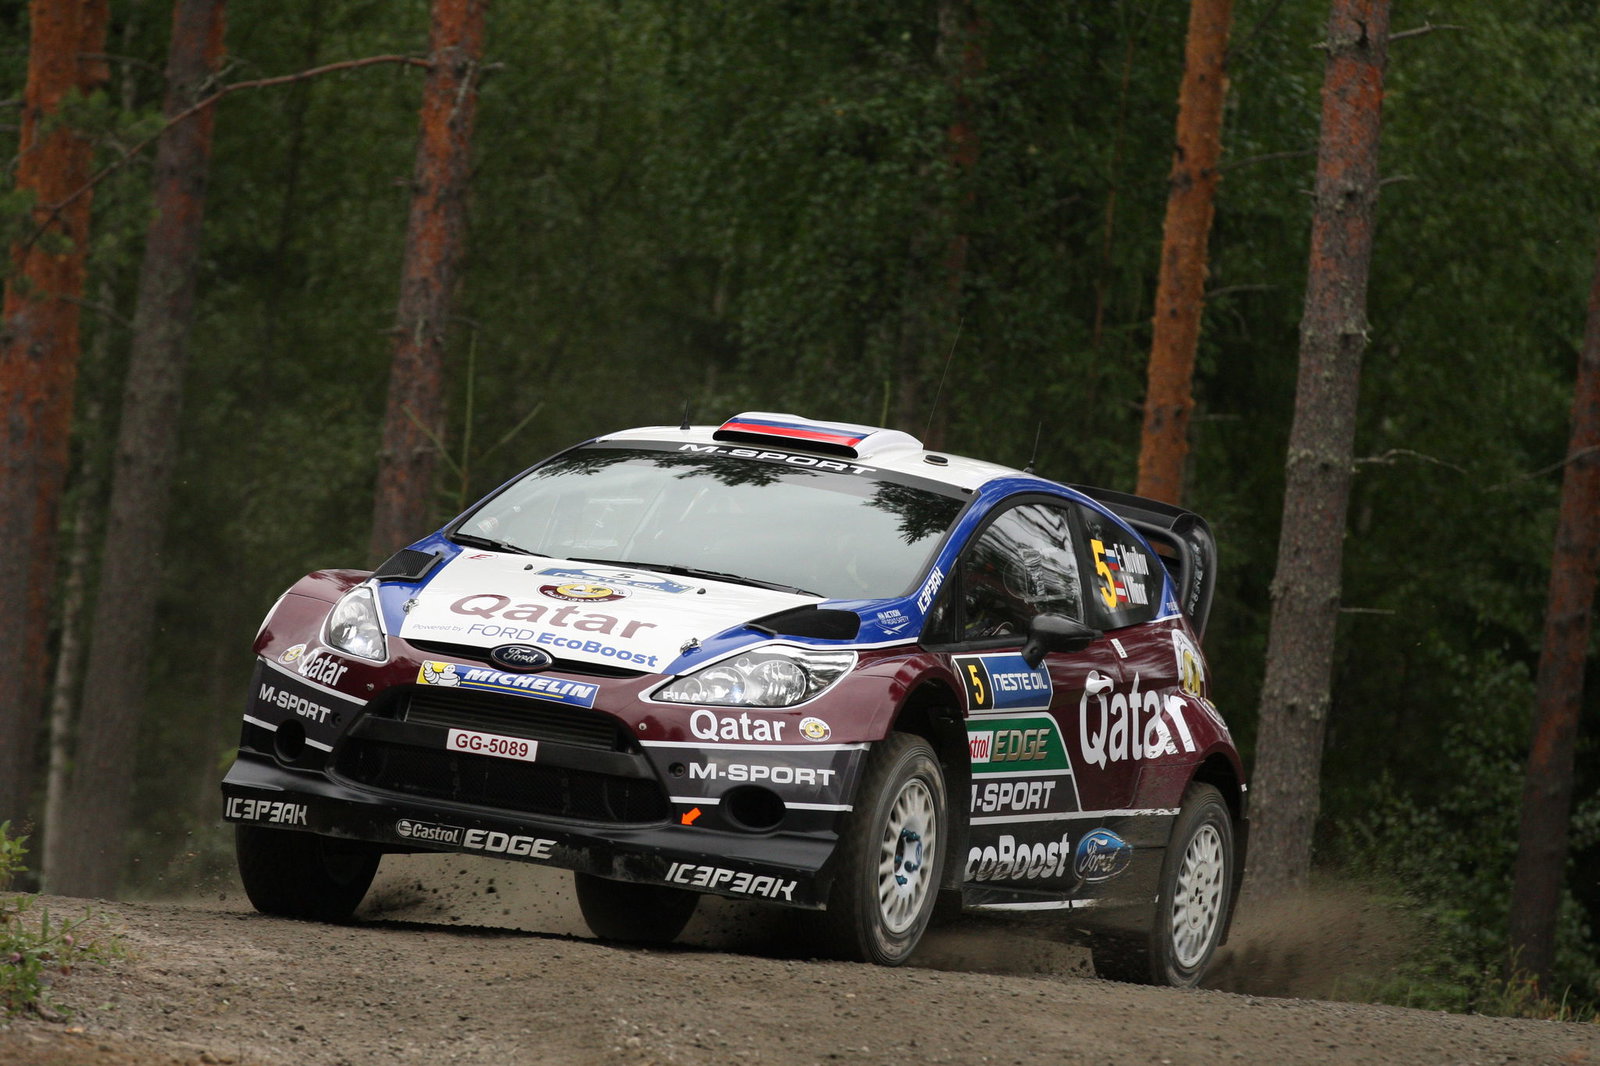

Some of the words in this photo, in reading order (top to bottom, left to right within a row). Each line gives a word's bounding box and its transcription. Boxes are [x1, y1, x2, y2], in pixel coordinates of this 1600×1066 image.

[679, 443, 876, 475] M-SPORT
[1090, 538, 1117, 608] 5
[449, 593, 658, 639] Qatar
[412, 623, 451, 631] Powered
[452, 624, 464, 632] by
[467, 623, 535, 641] FORD
[536, 632, 658, 667] EcoBoost
[503, 647, 539, 663] Ford
[298, 646, 349, 687] Qatar
[463, 668, 594, 699] MICHELIN
[967, 664, 985, 705] 5
[992, 672, 1029, 692] NESTE
[1030, 672, 1048, 690] OIL
[258, 683, 331, 724] M-SPORT
[1079, 671, 1197, 771] Qatar
[690, 709, 786, 742] Qatar
[455, 733, 529, 758] GG-5089
[969, 735, 990, 759] strol
[991, 729, 1051, 762] EDGE
[688, 762, 836, 786] M-SPORT
[412, 823, 459, 843] Castrol
[463, 828, 558, 860] EDGE
[964, 832, 1070, 882] coBoost
[1079, 837, 1122, 873] Ford
